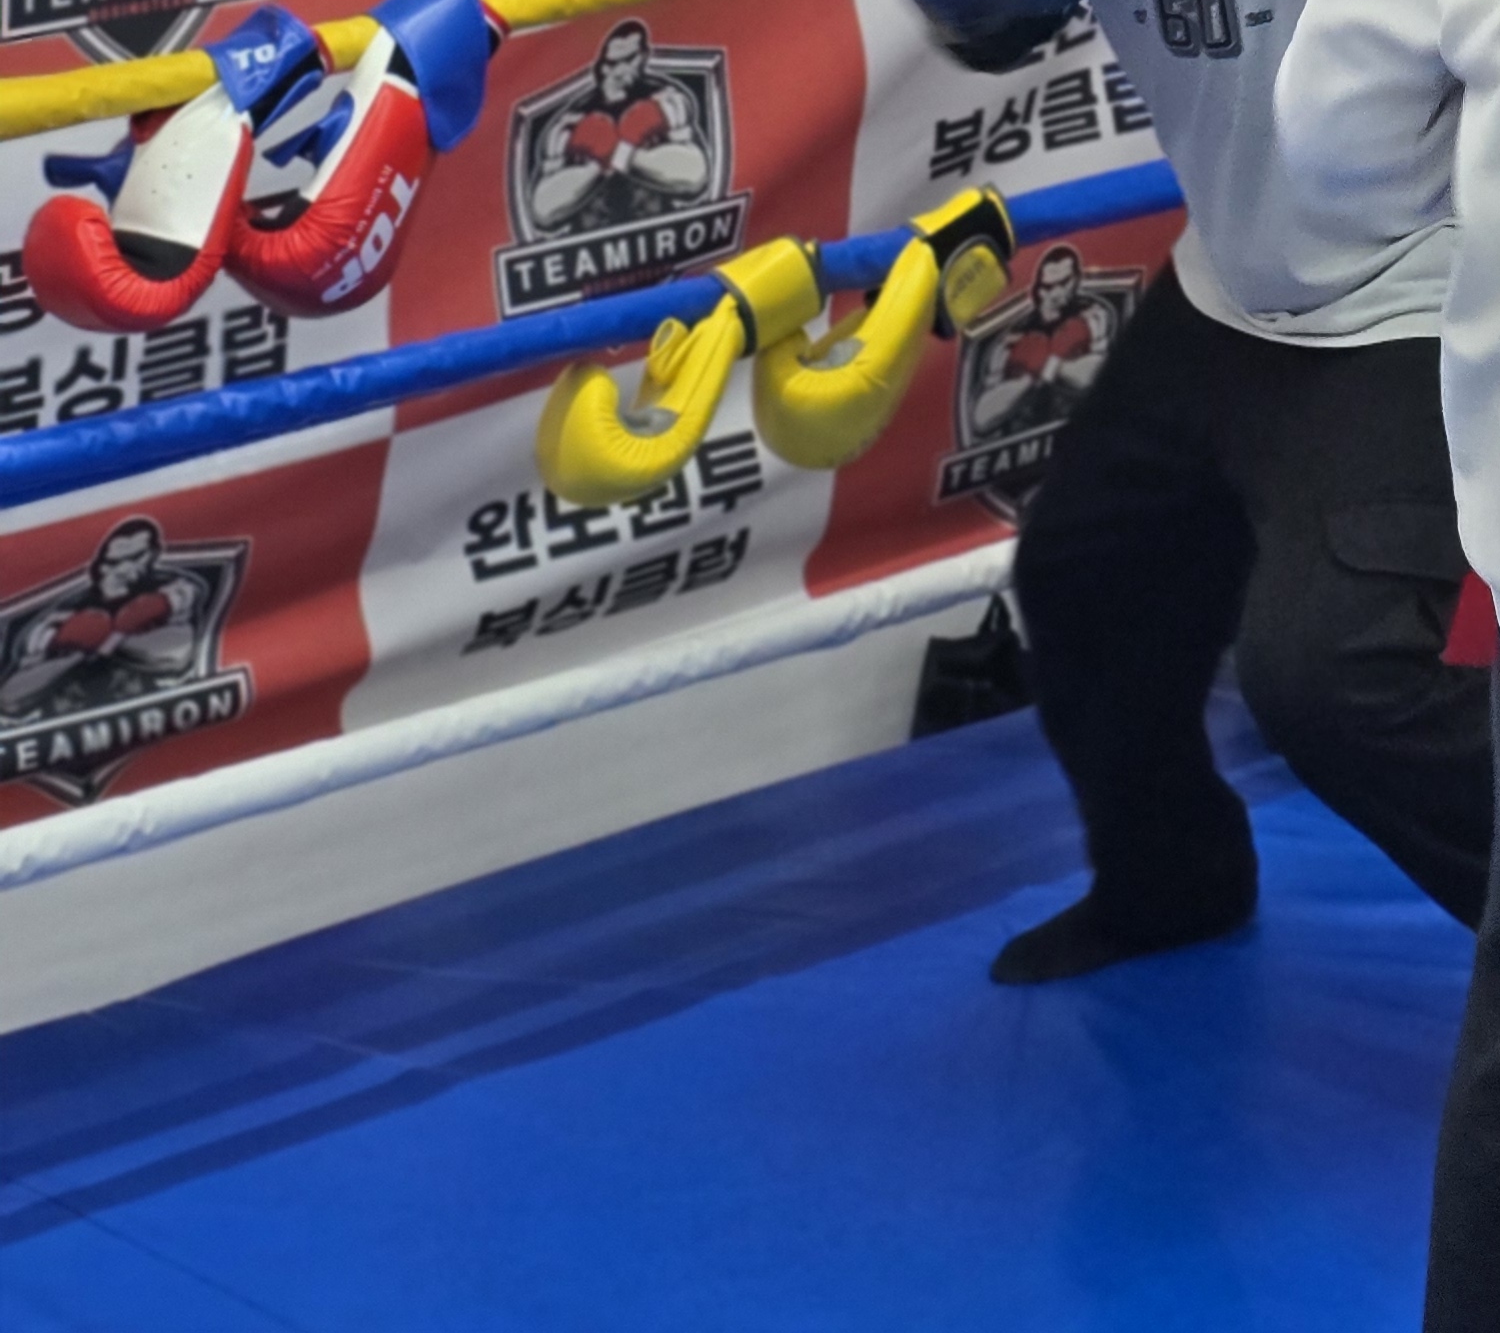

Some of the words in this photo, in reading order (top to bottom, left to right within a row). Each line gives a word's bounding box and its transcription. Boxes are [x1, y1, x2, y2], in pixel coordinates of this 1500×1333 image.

[513, 213, 732, 293] TEAMIRON
[951, 433, 1053, 489] TEAMI
[0, 690, 232, 771] EAMIRON
